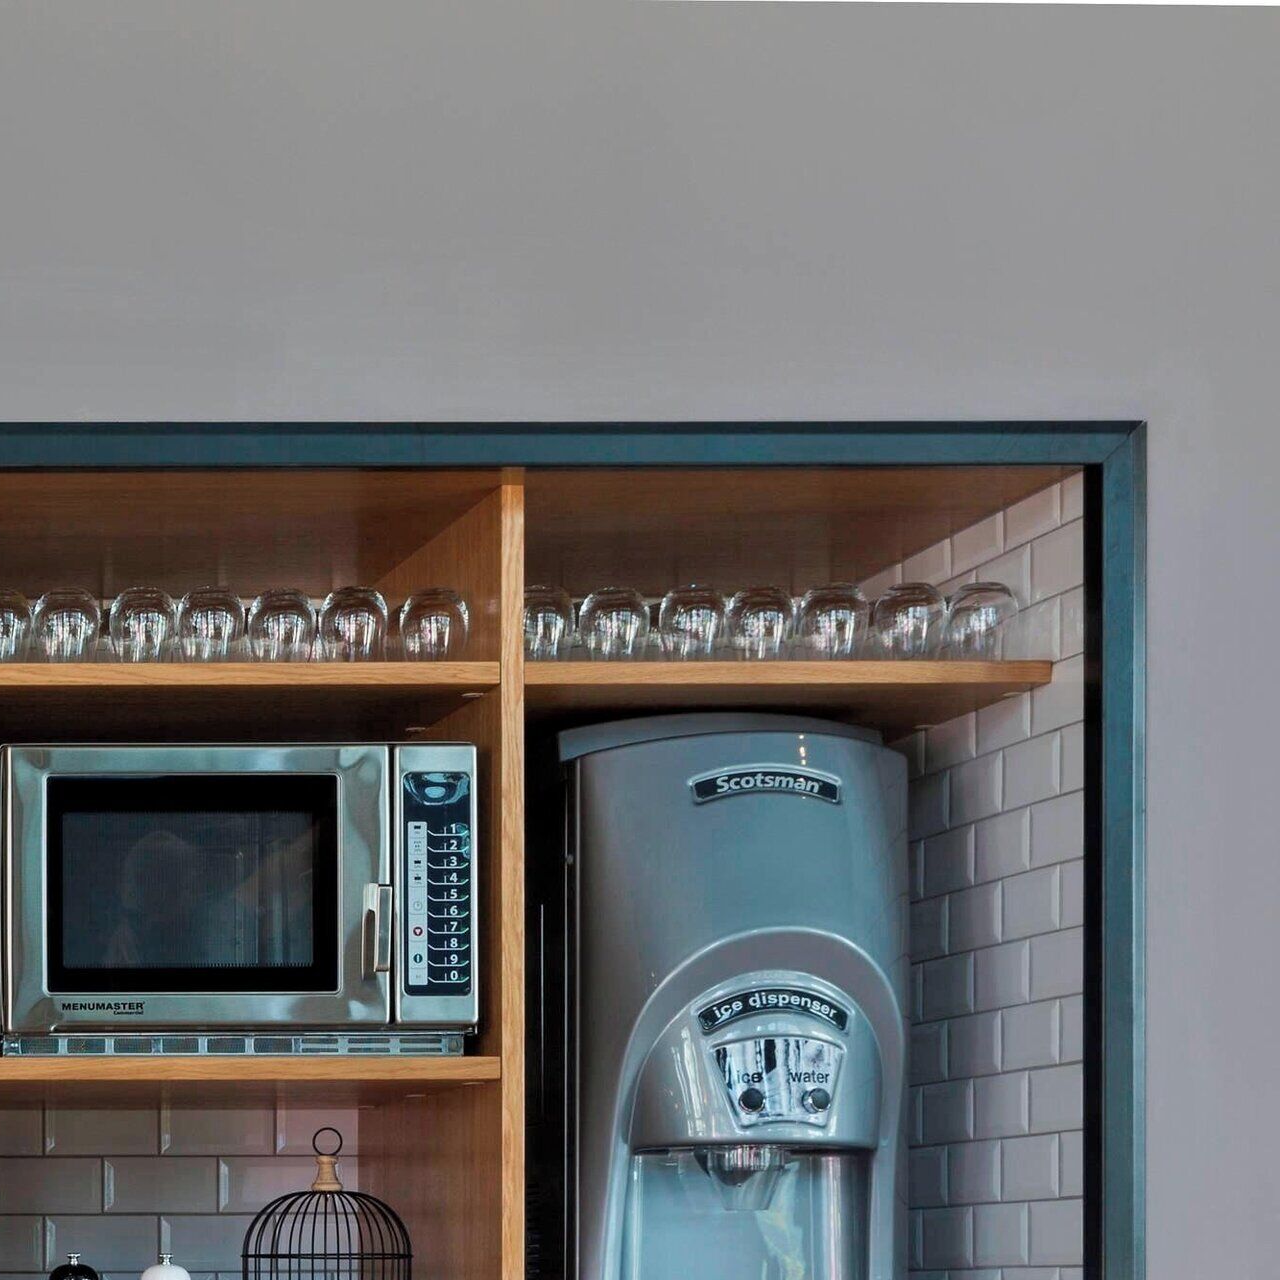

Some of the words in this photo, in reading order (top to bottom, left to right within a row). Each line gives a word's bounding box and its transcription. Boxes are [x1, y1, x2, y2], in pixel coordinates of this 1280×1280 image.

[716, 773, 820, 794] Scotsman
[450, 824, 458, 834] 1
[450, 840, 458, 850] 2
[450, 857, 458, 866] 3
[450, 873, 458, 882] 4
[450, 890, 458, 899] 5
[450, 906, 458, 916] 6
[450, 922, 458, 932] 7
[450, 938, 458, 948] 8
[450, 955, 458, 964] 9
[450, 971, 458, 980] 0
[62, 1002, 144, 1010] MENUMASTER
[713, 1000, 742, 1018] ice
[749, 992, 838, 1018] dispenser
[737, 1070, 763, 1084] ice
[790, 1072, 830, 1084] water
